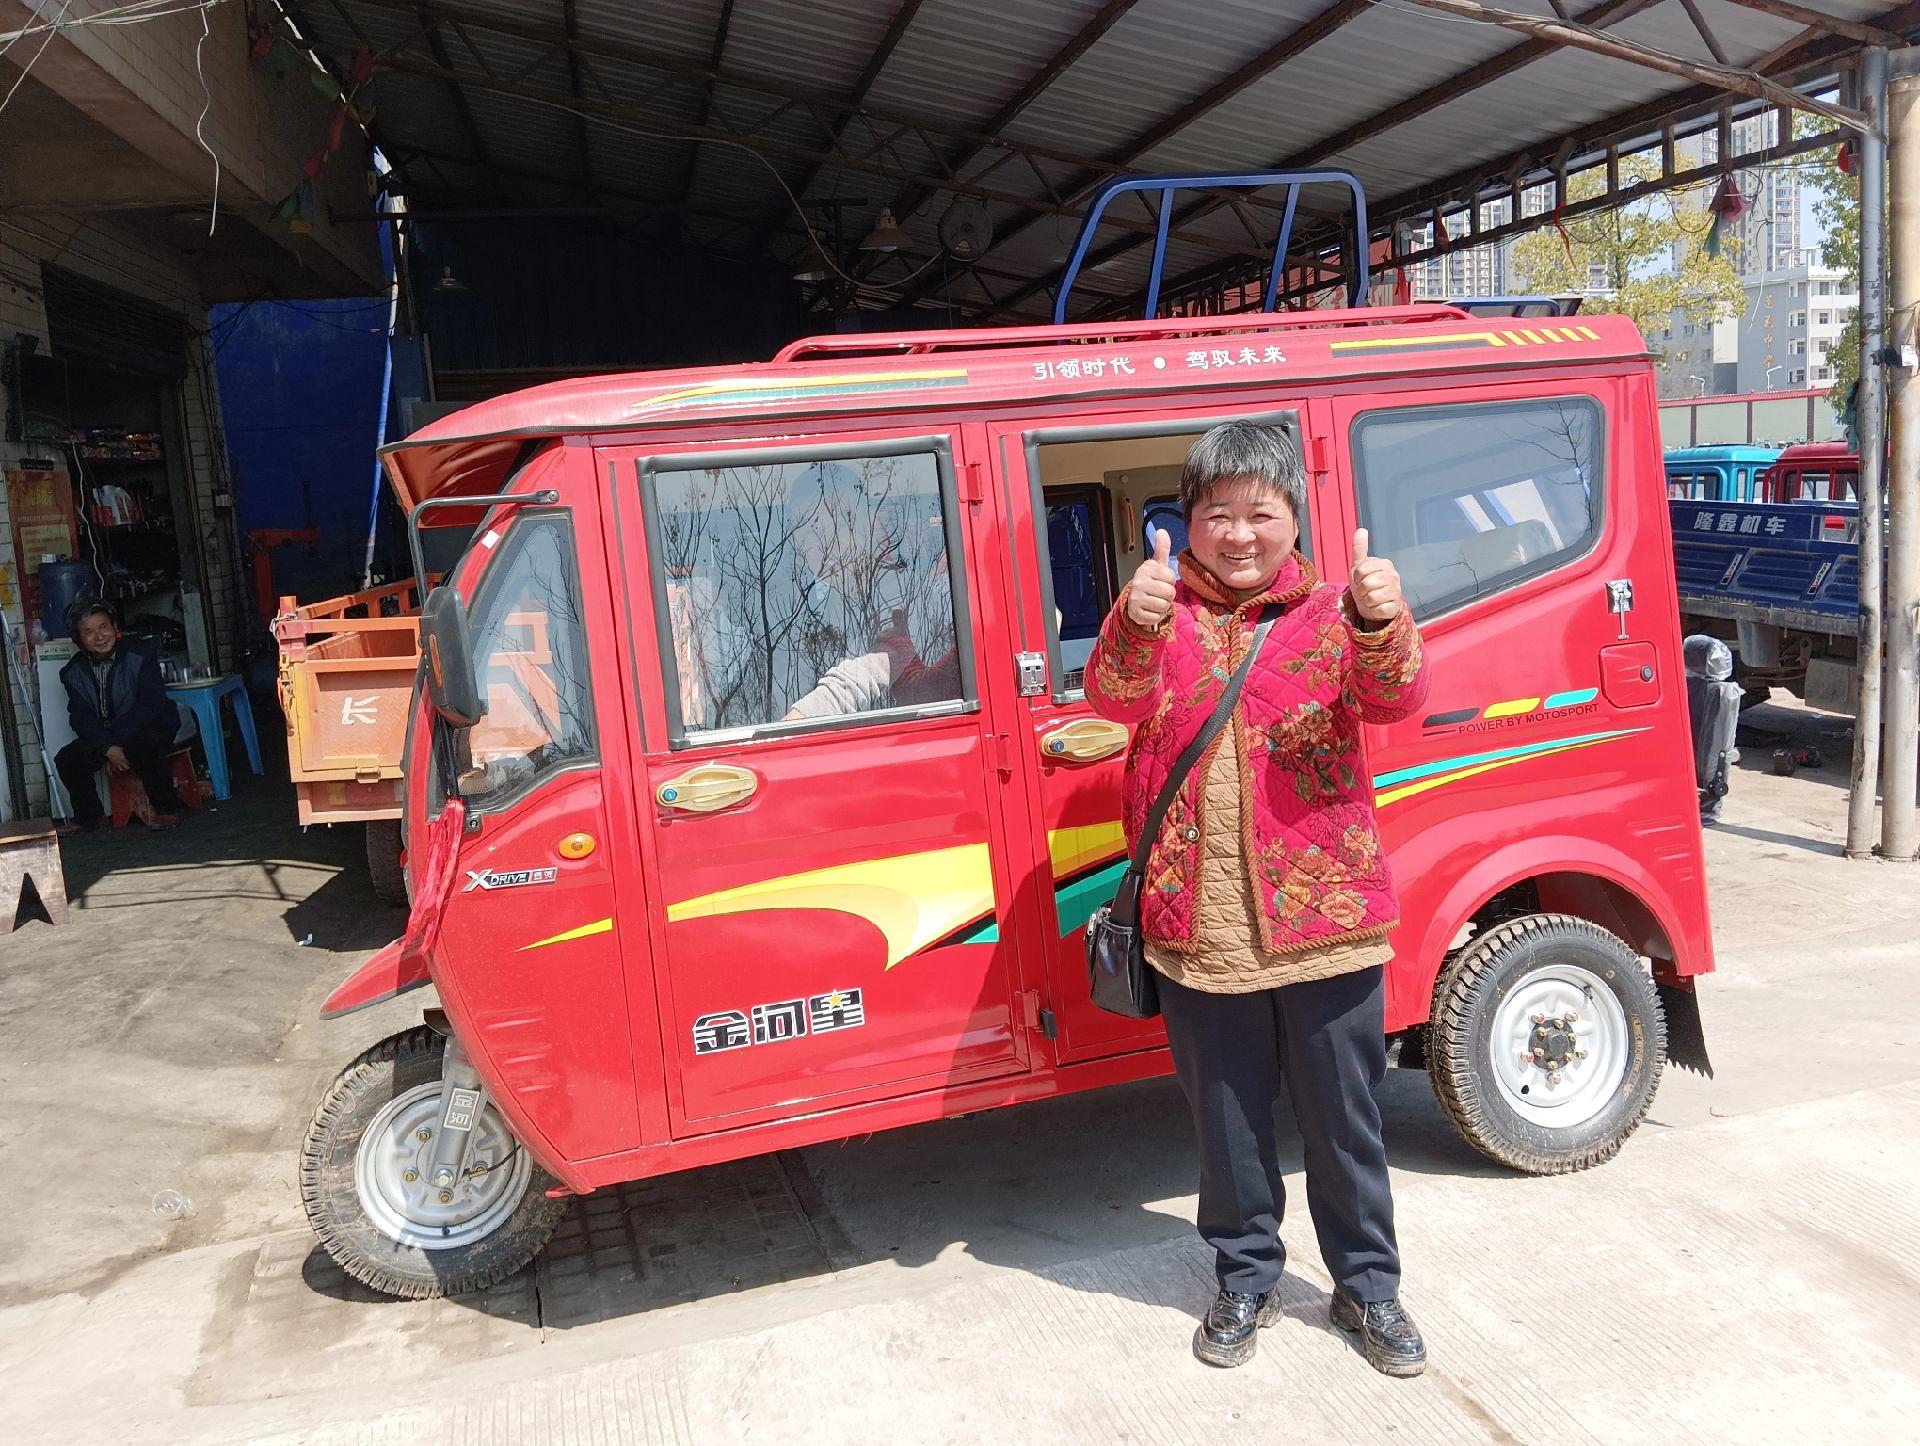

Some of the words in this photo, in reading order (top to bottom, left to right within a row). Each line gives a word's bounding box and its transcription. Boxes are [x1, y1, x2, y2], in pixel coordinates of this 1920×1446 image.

[1031, 356, 1137, 381] 引领时代
[1185, 344, 1287, 370] 驾驭未来
[1693, 511, 1787, 536] 隆鑫机车
[1458, 719, 1503, 735] POWER
[1506, 716, 1523, 728] BY
[1526, 703, 1600, 724] MOTOSPORT
